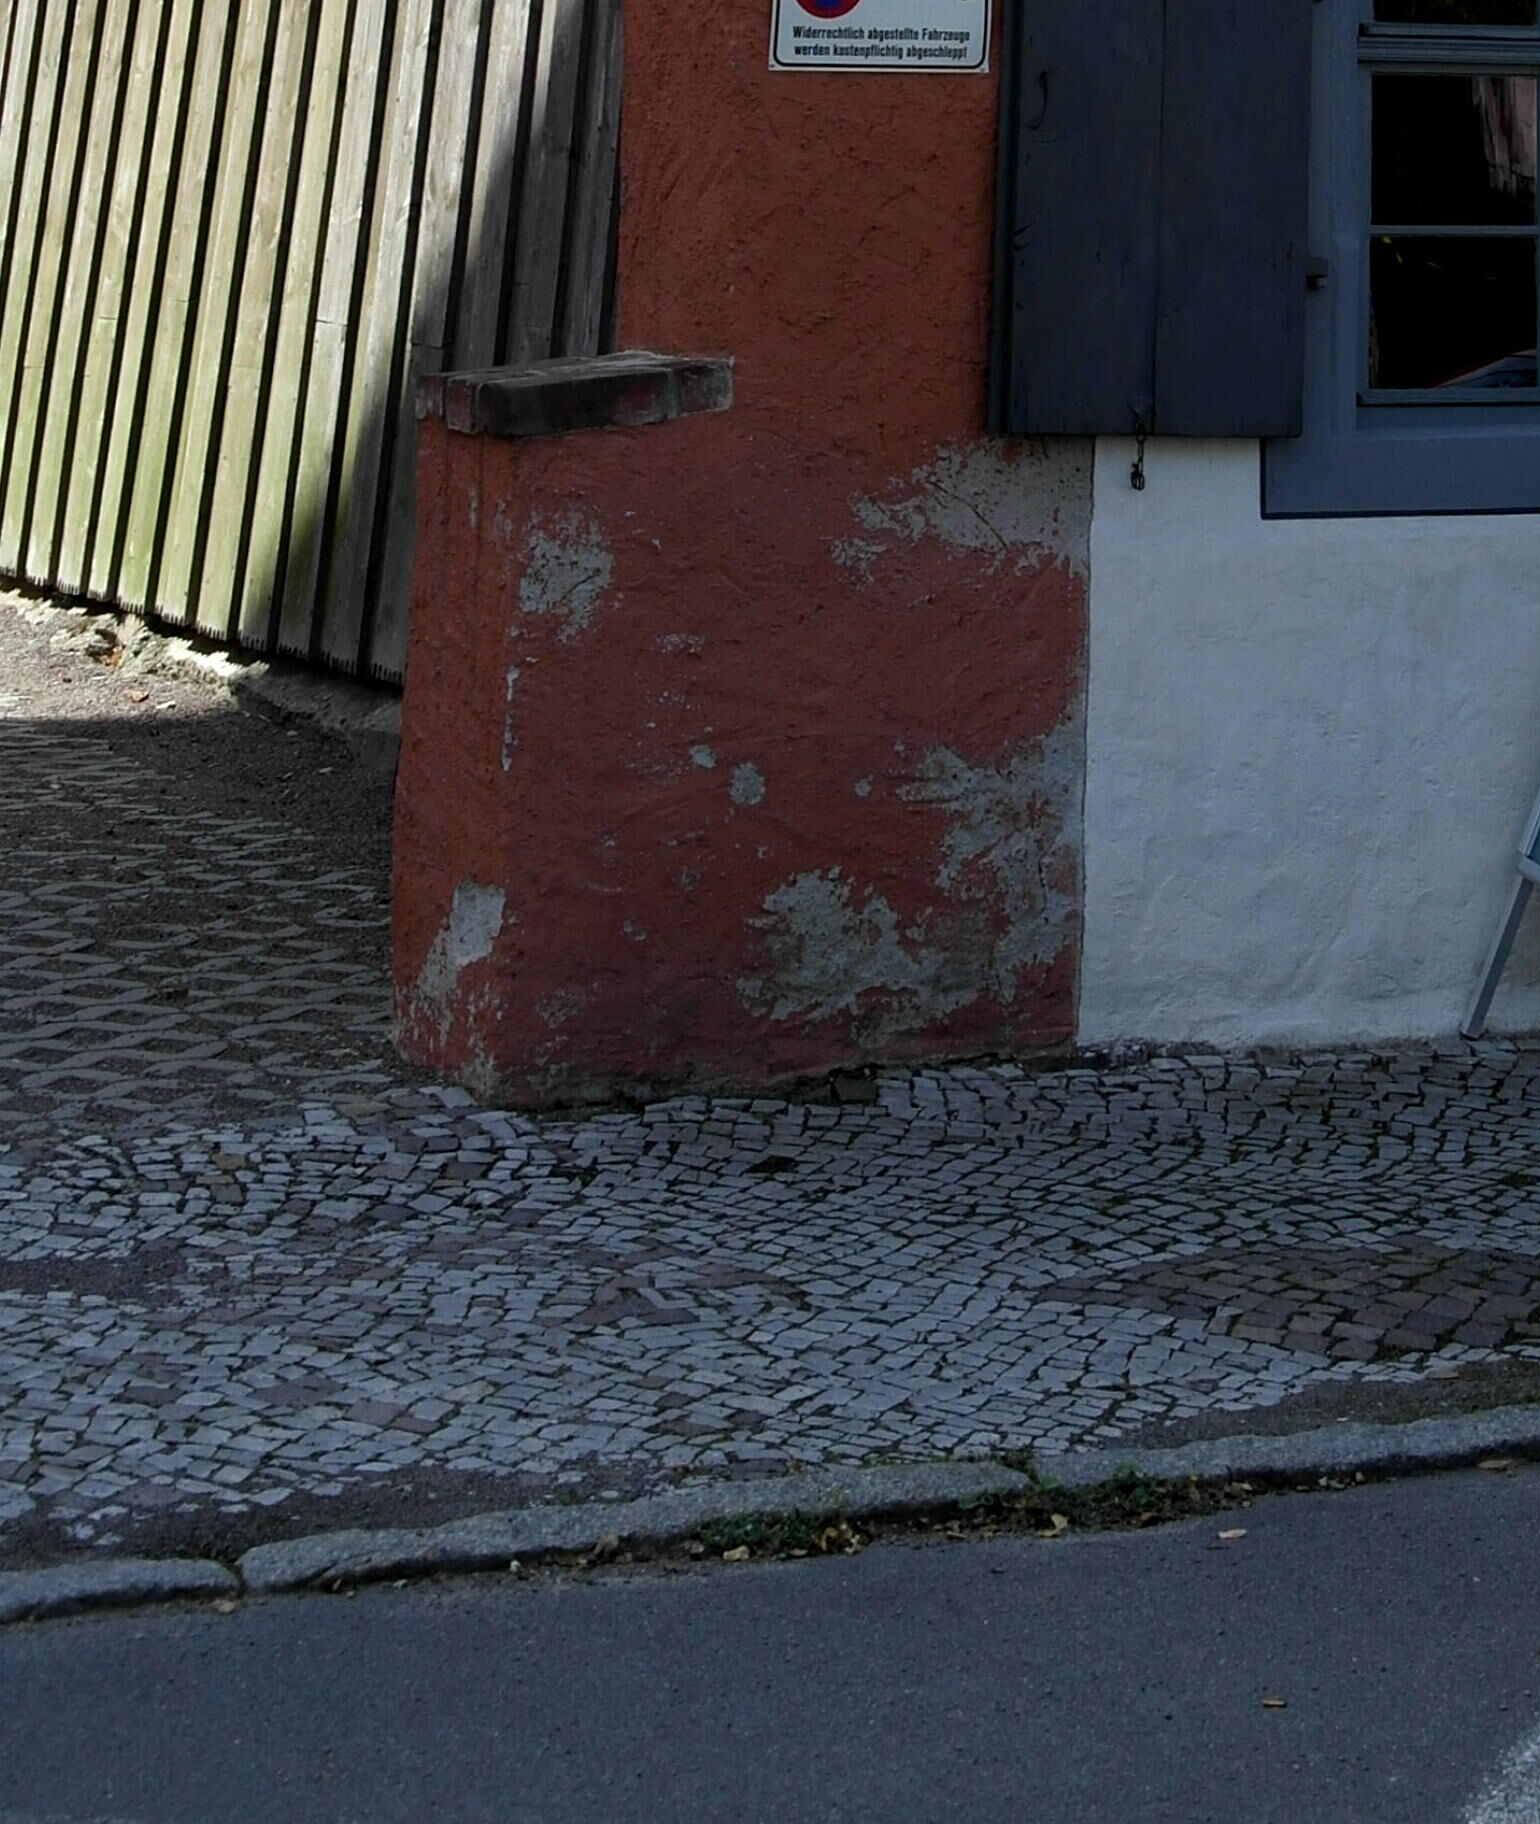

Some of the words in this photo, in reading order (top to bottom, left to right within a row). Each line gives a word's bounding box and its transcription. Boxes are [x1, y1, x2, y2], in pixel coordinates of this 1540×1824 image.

[793, 25, 865, 41] Widerrechtlich
[867, 27, 920, 43] abgestellte
[921, 28, 971, 44] Fahrzeuge
[794, 44, 830, 57] werden
[833, 43, 904, 59] kostenpflichtig
[906, 45, 968, 61] abgeschleppt
